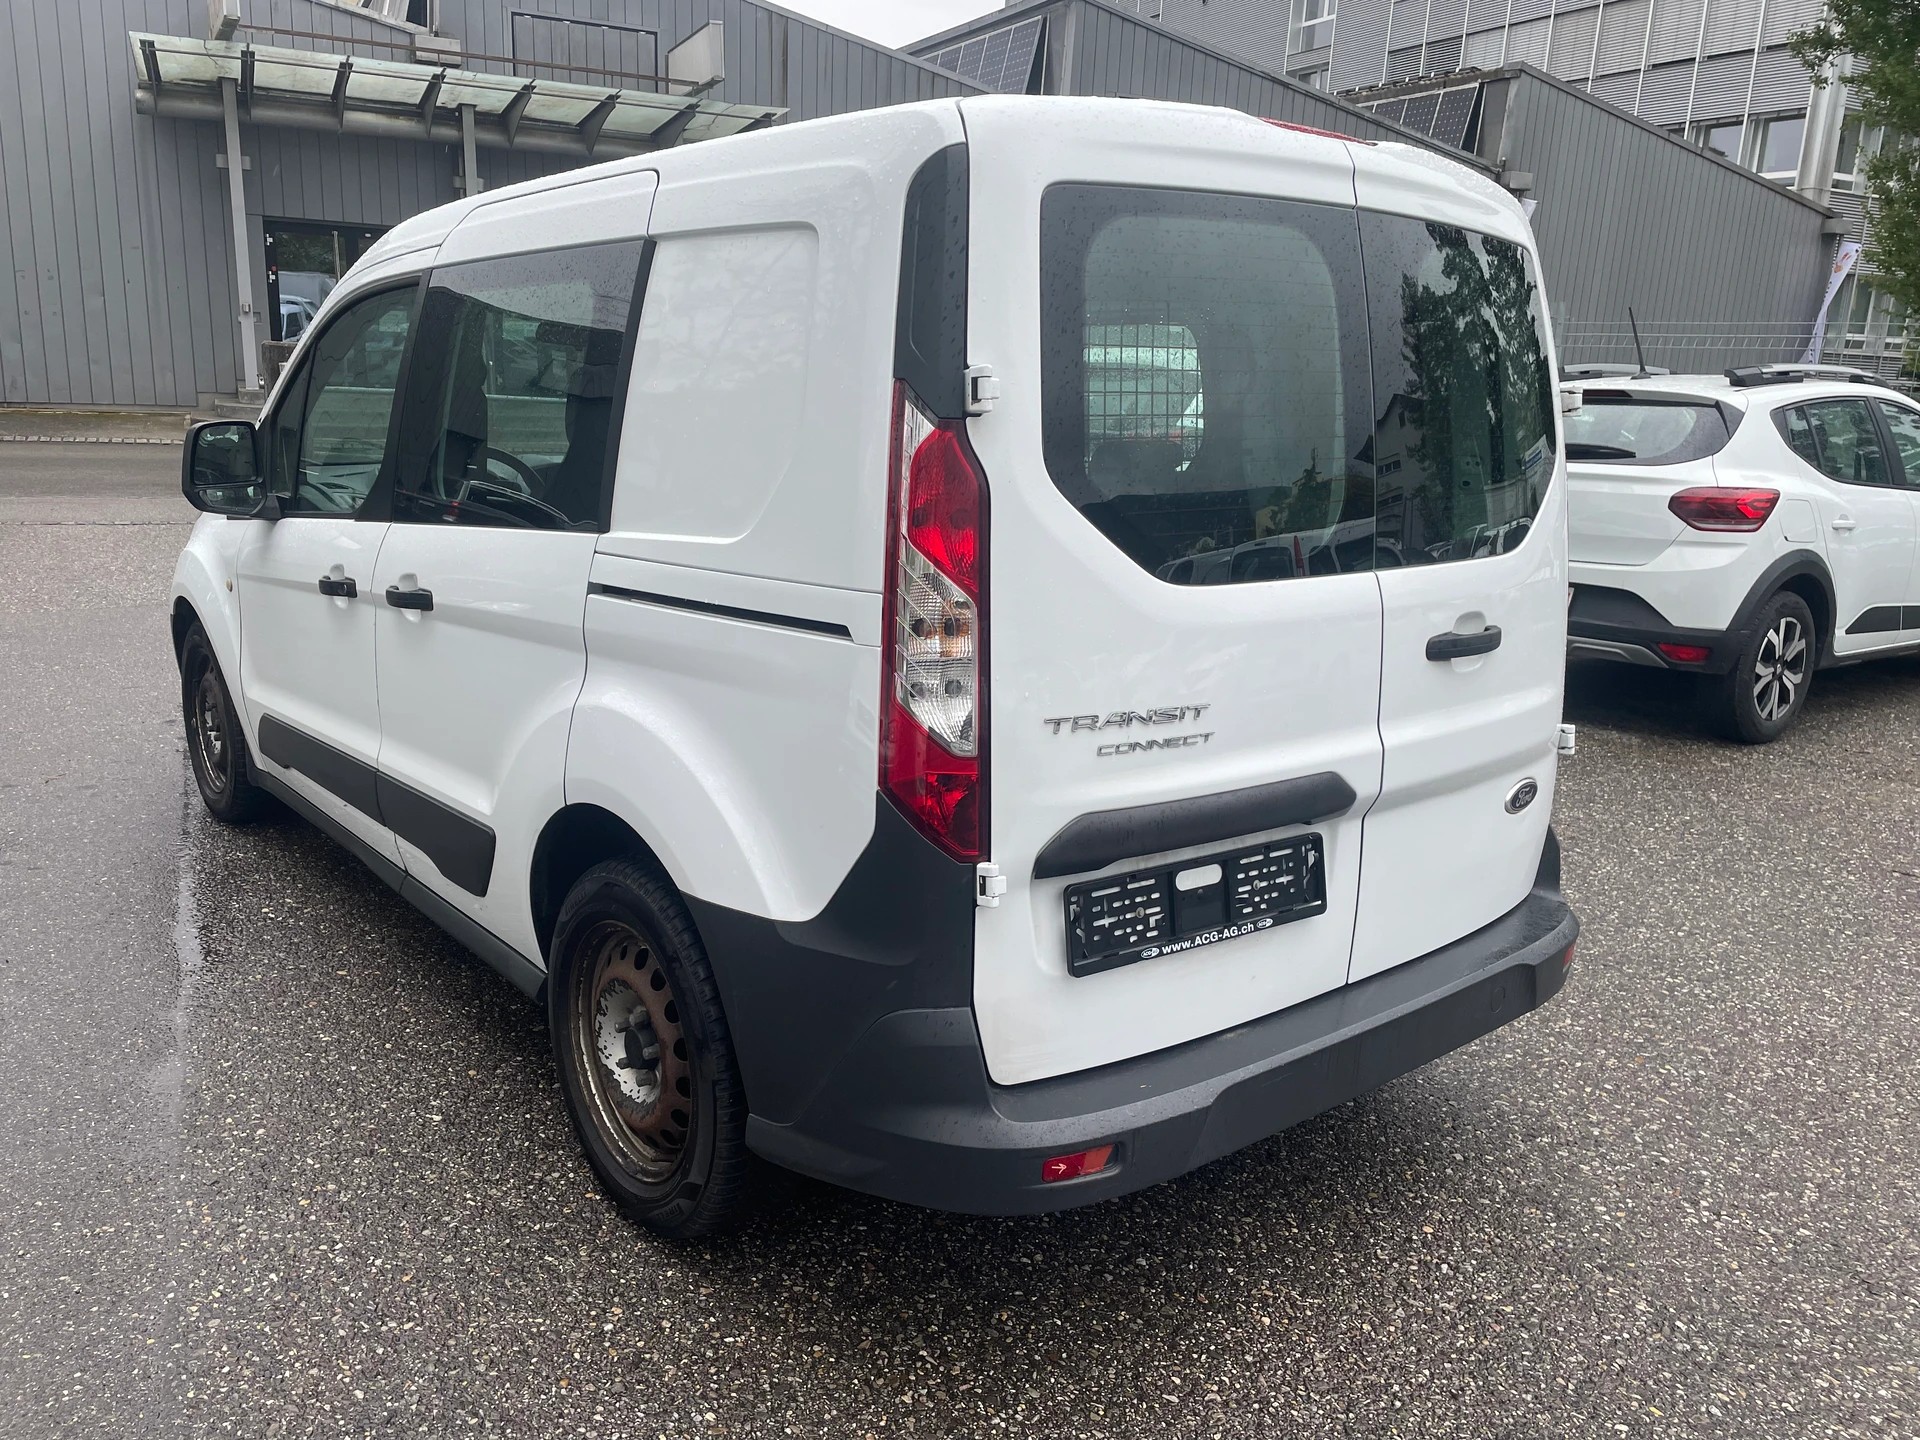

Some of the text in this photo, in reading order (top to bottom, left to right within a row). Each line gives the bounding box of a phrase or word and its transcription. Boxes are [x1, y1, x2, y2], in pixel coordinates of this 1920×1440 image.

[1044, 703, 1211, 735] TRANSIT
[1096, 731, 1216, 757] CONNECT
[1161, 922, 1255, 954] www.ACG-AG.ch
